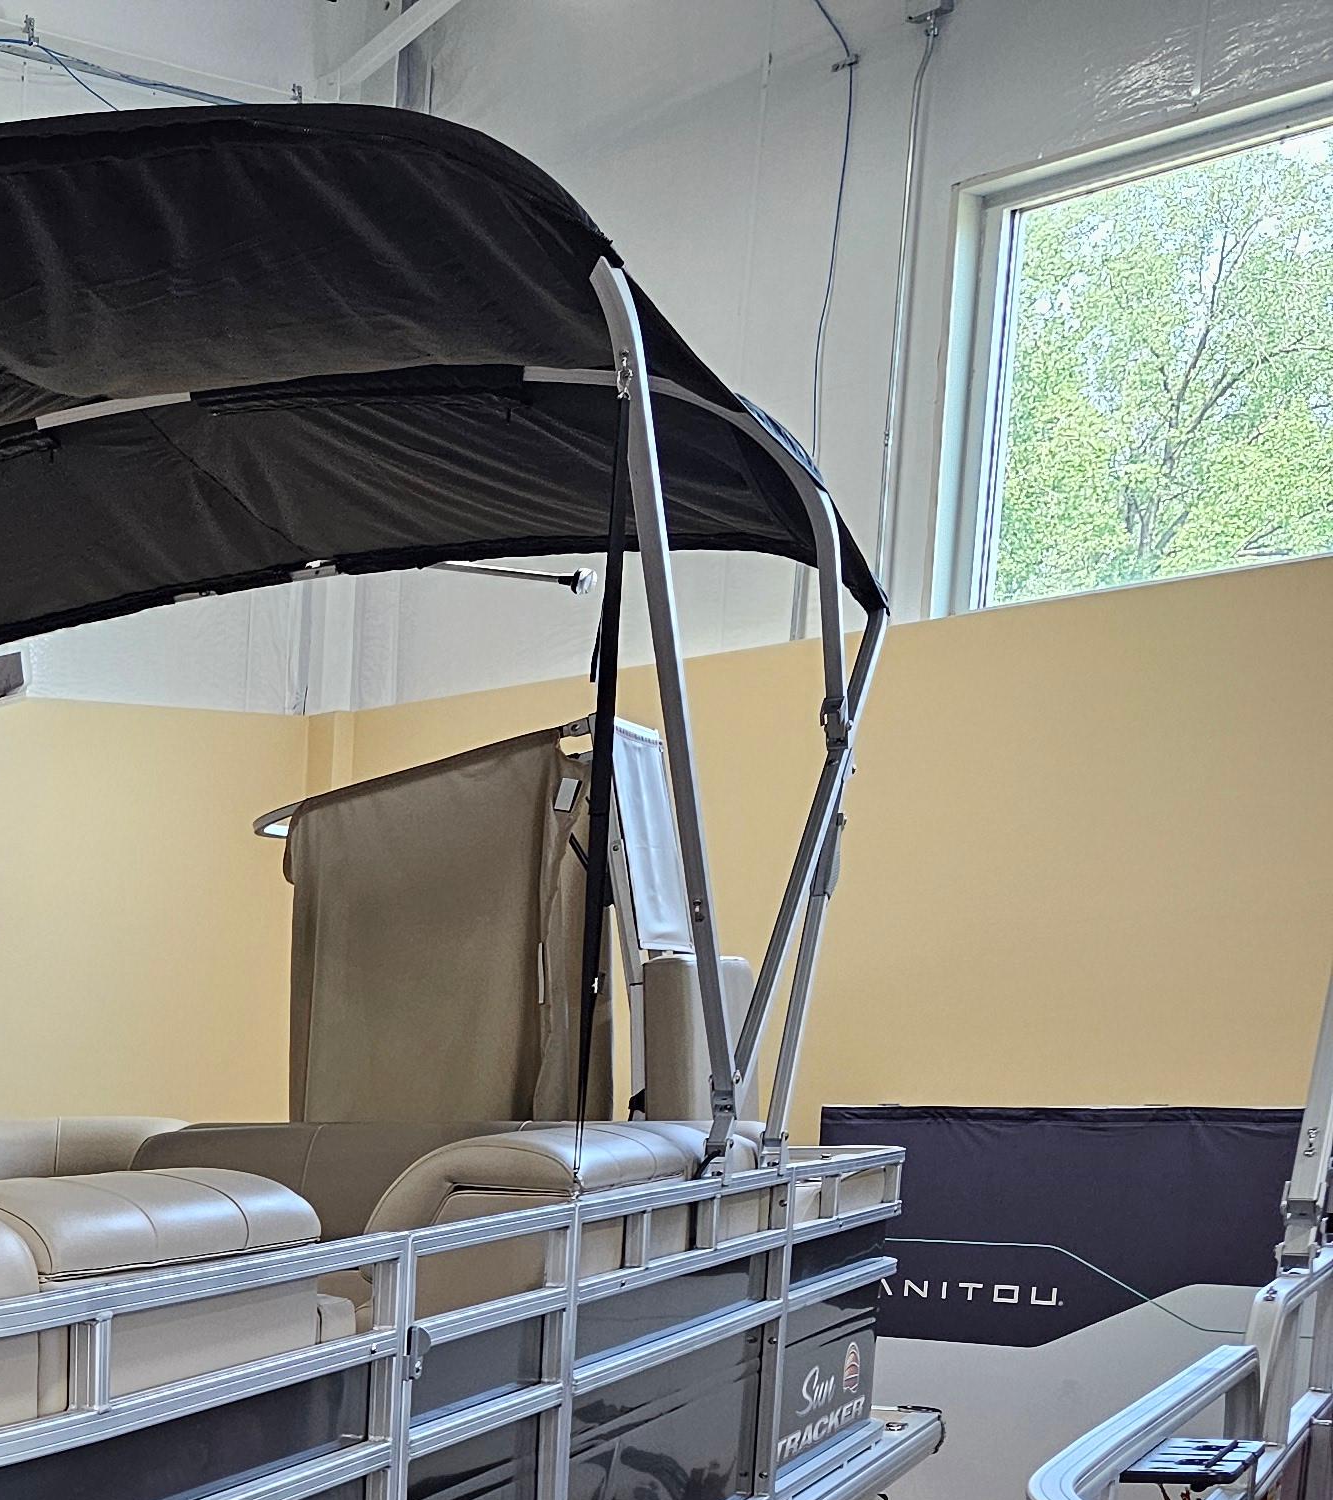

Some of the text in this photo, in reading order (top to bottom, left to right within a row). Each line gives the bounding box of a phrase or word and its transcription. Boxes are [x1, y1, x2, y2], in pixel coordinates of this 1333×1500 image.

[878, 1279, 1058, 1306] ANITOU
[795, 1365, 835, 1417] Sun
[776, 1394, 865, 1462] TRACKER
